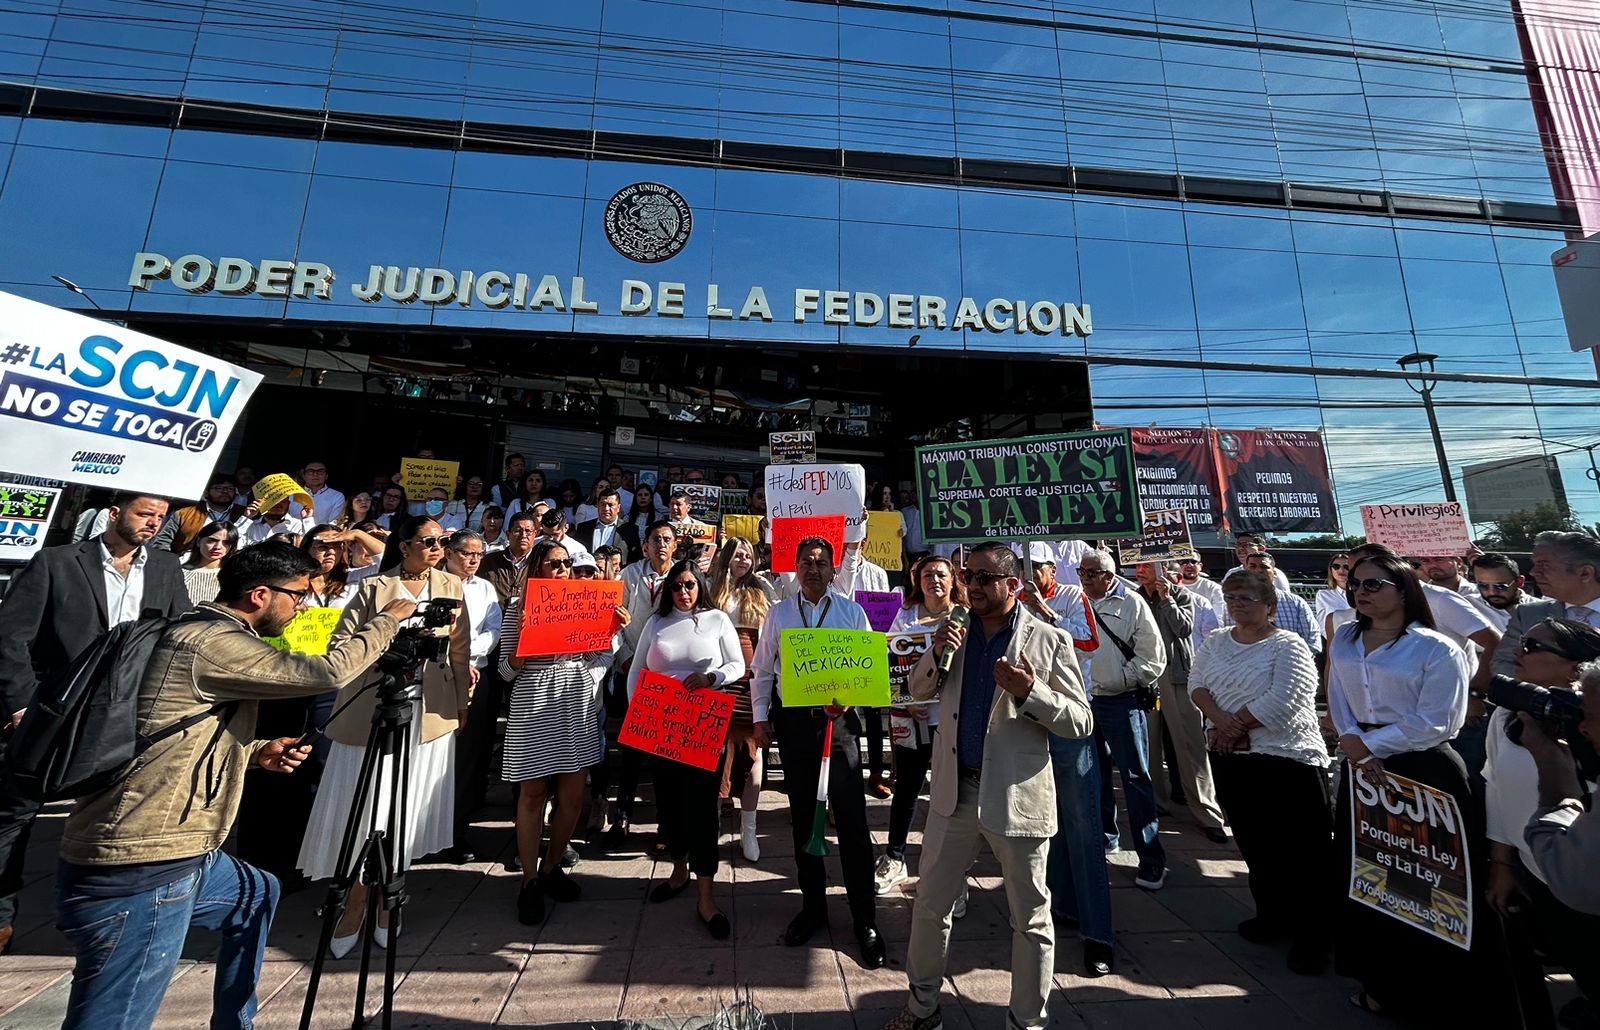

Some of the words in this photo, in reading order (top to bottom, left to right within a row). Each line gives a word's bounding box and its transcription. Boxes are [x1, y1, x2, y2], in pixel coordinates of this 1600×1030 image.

[609, 186, 638, 211] ESTADOS
[638, 184, 669, 195] UNIDOS
[668, 192, 691, 232] MEXICANOS
[128, 252, 335, 300] PODER
[352, 265, 598, 313] JUDICIAL
[620, 279, 685, 317] DE
[707, 284, 773, 322] LA
[794, 288, 1093, 337] FEDERACION
[1, 342, 66, 376] #LA
[69, 335, 241, 419] SCJN
[1, 384, 60, 417] NO
[63, 399, 110, 428] SE
[112, 409, 184, 445] TOCA
[772, 433, 813, 443] SCJN
[71, 451, 126, 465] CAMBIEMOS
[922, 449, 967, 464] MÁXIMO
[969, 446, 1025, 460] TRIBUNAL
[1026, 436, 1127, 454] CONSTITUCIONAL
[994, 451, 1066, 486] LEY
[1256, 472, 1292, 484] PEDIMOS
[673, 486, 719, 498] SCJN
[938, 489, 985, 501] SUPREMA
[989, 486, 1022, 498] CORTE
[1024, 486, 1038, 497] de
[1039, 483, 1095, 496] JUSTICIA
[1149, 482, 1198, 496] INTROMISIÓN
[1201, 484, 1210, 496] AL
[1237, 492, 1271, 503] RESPETO
[1272, 493, 1278, 503] A
[1280, 493, 1318, 503] NUESTROS
[772, 501, 783, 517] el
[930, 500, 972, 530] ES
[980, 497, 1028, 528] LA
[1037, 491, 1125, 525] LEY!
[1170, 498, 1199, 510] AFECTA
[1201, 498, 1210, 510] LA
[1239, 507, 1277, 517] DERECHOS
[1280, 507, 1321, 517] LABORALES
[1379, 503, 1460, 520] Privilegios?
[985, 526, 997, 537] de
[999, 526, 1008, 536] la
[1010, 523, 1050, 536] NACIÓN
[540, 585, 556, 603] De
[567, 586, 598, 601] mentira
[602, 590, 618, 600] nace
[531, 602, 540, 615] la
[573, 600, 584, 610] de
[588, 601, 597, 611] la
[529, 615, 540, 626] la
[589, 639, 609, 649] PJF
[789, 633, 814, 646] ESTA
[828, 634, 854, 643] LUCHA
[862, 635, 872, 644] ES
[795, 647, 813, 658] DEL
[820, 645, 852, 655] PUEBLO
[793, 656, 873, 677] MEXICANO
[641, 673, 667, 694] Leer
[801, 679, 840, 695] #respeto
[842, 679, 851, 689] al
[853, 676, 873, 688] PJF
[632, 707, 641, 719] es
[696, 711, 728, 731] PJF
[1356, 767, 1456, 834] SCJN
[1360, 819, 1407, 849] Porque
[1411, 838, 1428, 857] La
[1432, 844, 1458, 871] Ley
[1376, 851, 1392, 866] es
[1396, 857, 1412, 874] La
[1416, 862, 1441, 887] Ley
[1355, 879, 1464, 935] #YoApoyoALaSCJN
